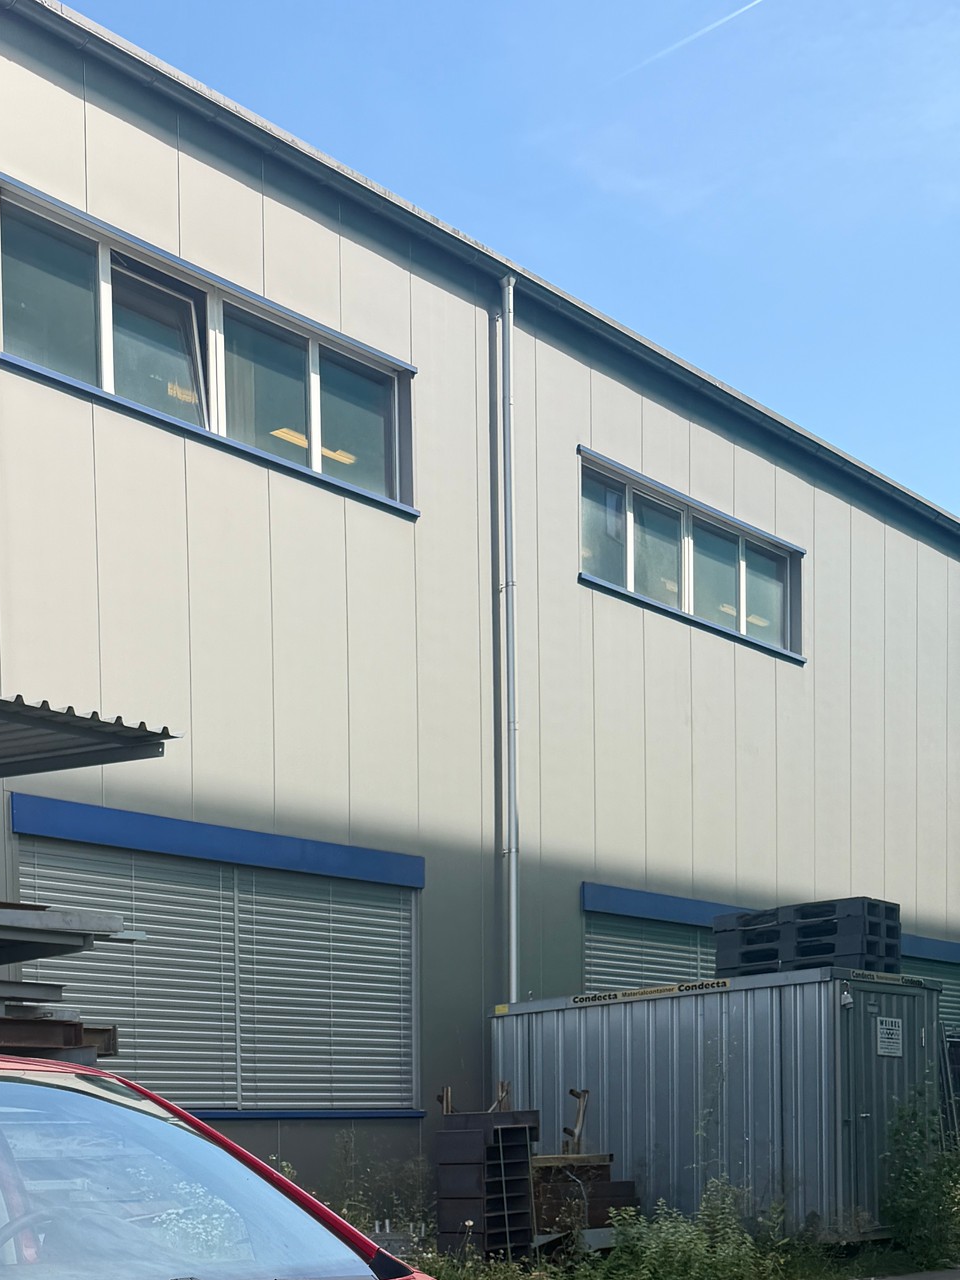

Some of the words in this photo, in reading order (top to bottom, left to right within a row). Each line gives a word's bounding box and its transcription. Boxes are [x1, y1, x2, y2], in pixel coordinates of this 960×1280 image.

[572, 993, 618, 1004] Condecta
[621, 986, 675, 998] Materialcontainer
[677, 980, 727, 992] Condecta
